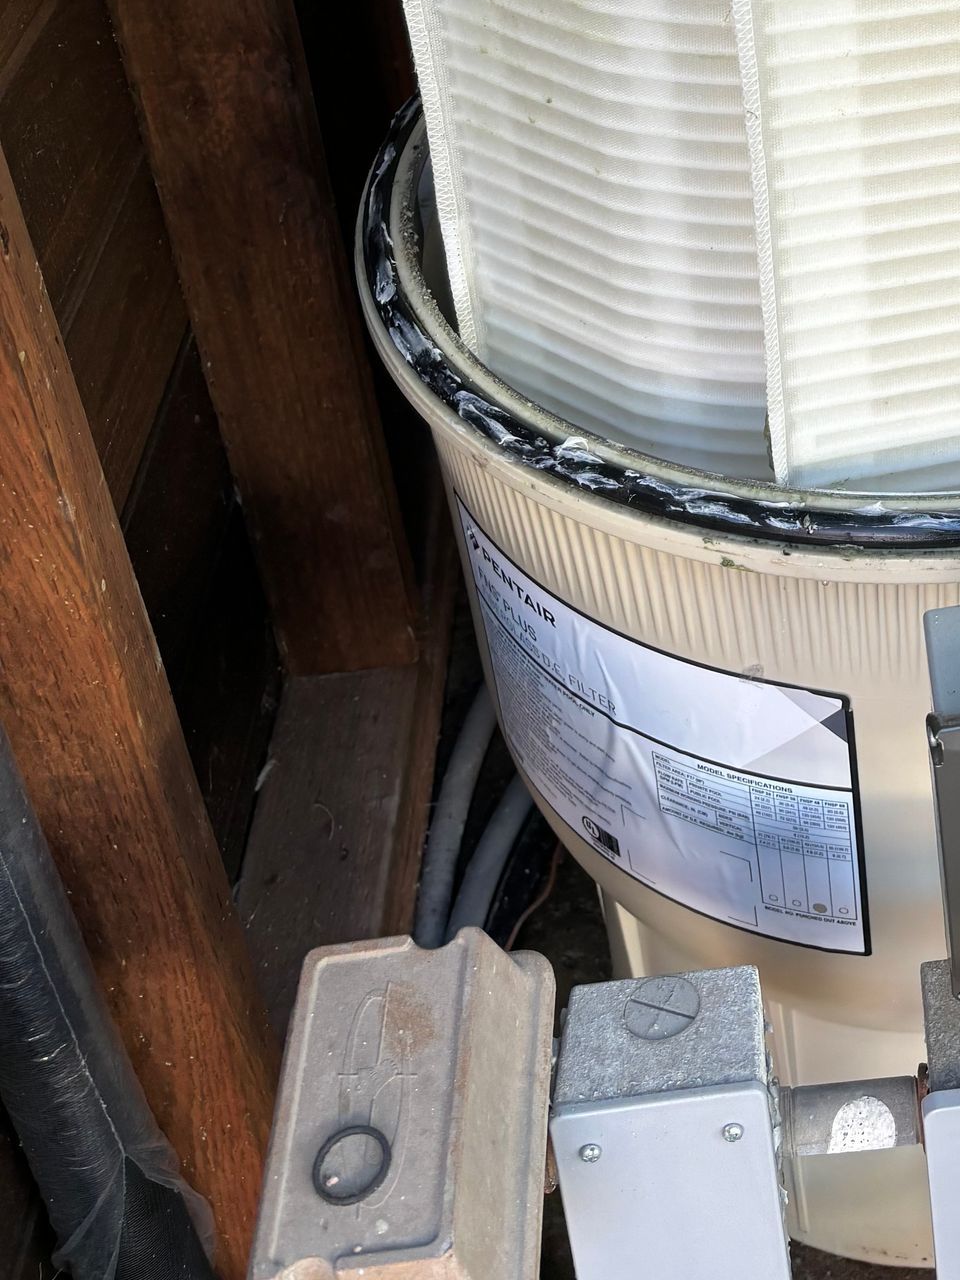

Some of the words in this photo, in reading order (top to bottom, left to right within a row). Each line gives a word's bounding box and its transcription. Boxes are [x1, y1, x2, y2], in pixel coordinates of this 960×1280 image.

[482, 546, 557, 628] PENTAIR
[503, 599, 537, 642] PLUS
[569, 674, 617, 716] FILTER
[697, 764, 725, 777] MODEL
[726, 774, 793, 794] SPECIFICATIONS
